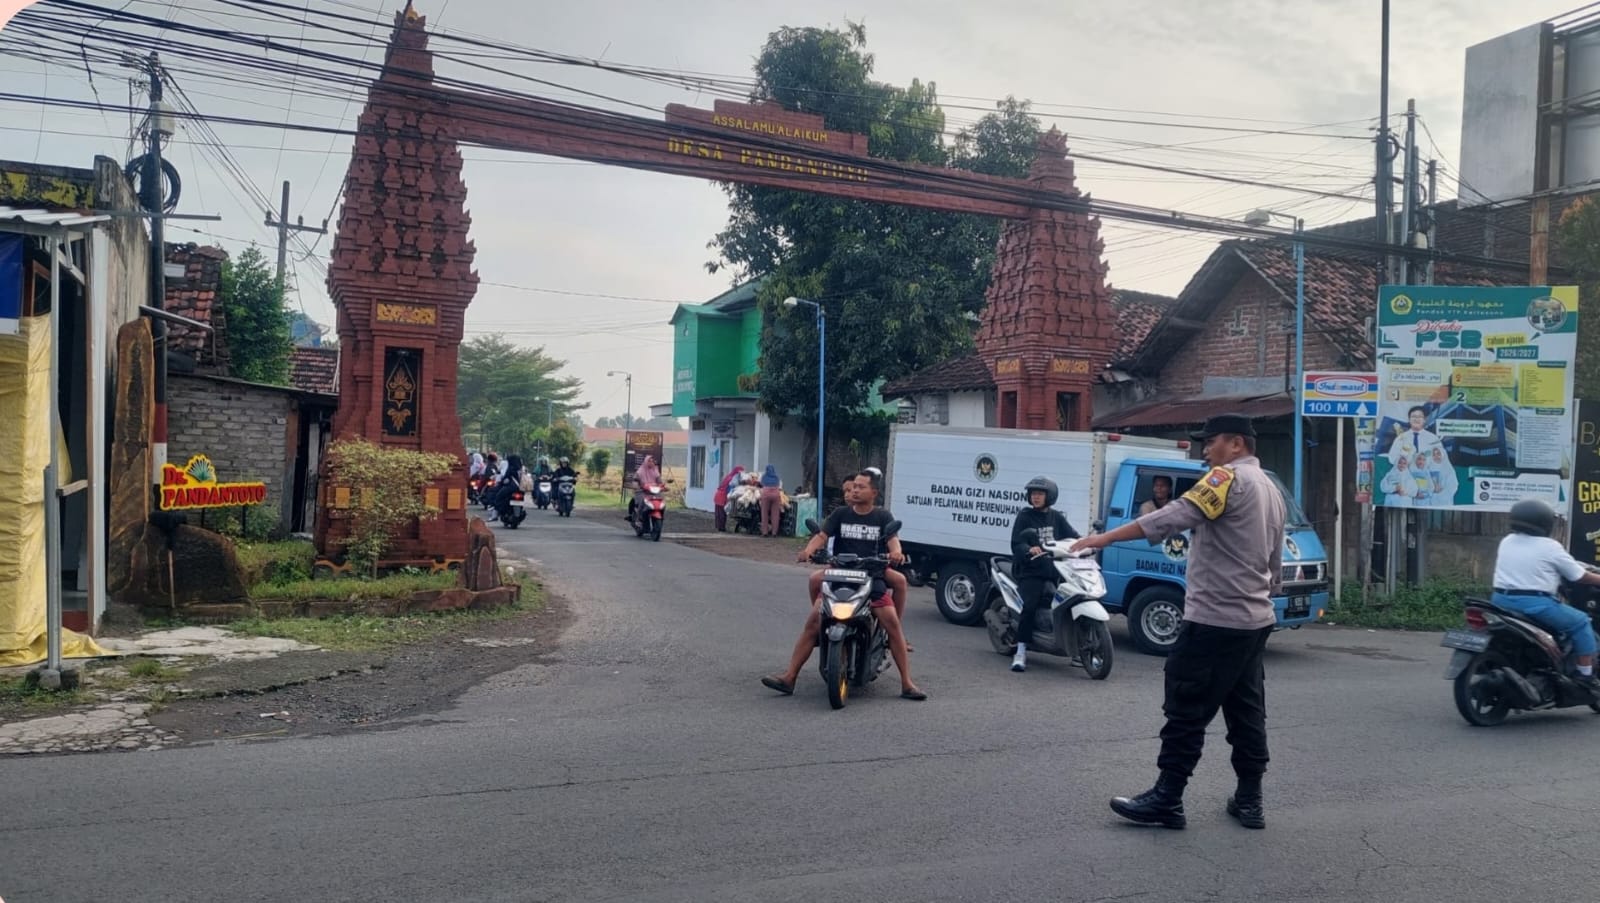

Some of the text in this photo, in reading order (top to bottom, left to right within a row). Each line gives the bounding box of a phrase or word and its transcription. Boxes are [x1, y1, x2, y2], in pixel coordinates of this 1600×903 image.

[1416, 330, 1482, 349] PSB
[1308, 402, 1348, 412] 100 M
[163, 485, 266, 507] PANDANTOYO
[931, 484, 1028, 502] BADAN GIZI NASION
[906, 495, 1021, 515] SATUAN PELAYANAN PEMENUHAN
[952, 513, 1010, 527] TEMU KUDU
[1135, 559, 1160, 571] BADAN
[1161, 562, 1176, 574] GIZI
